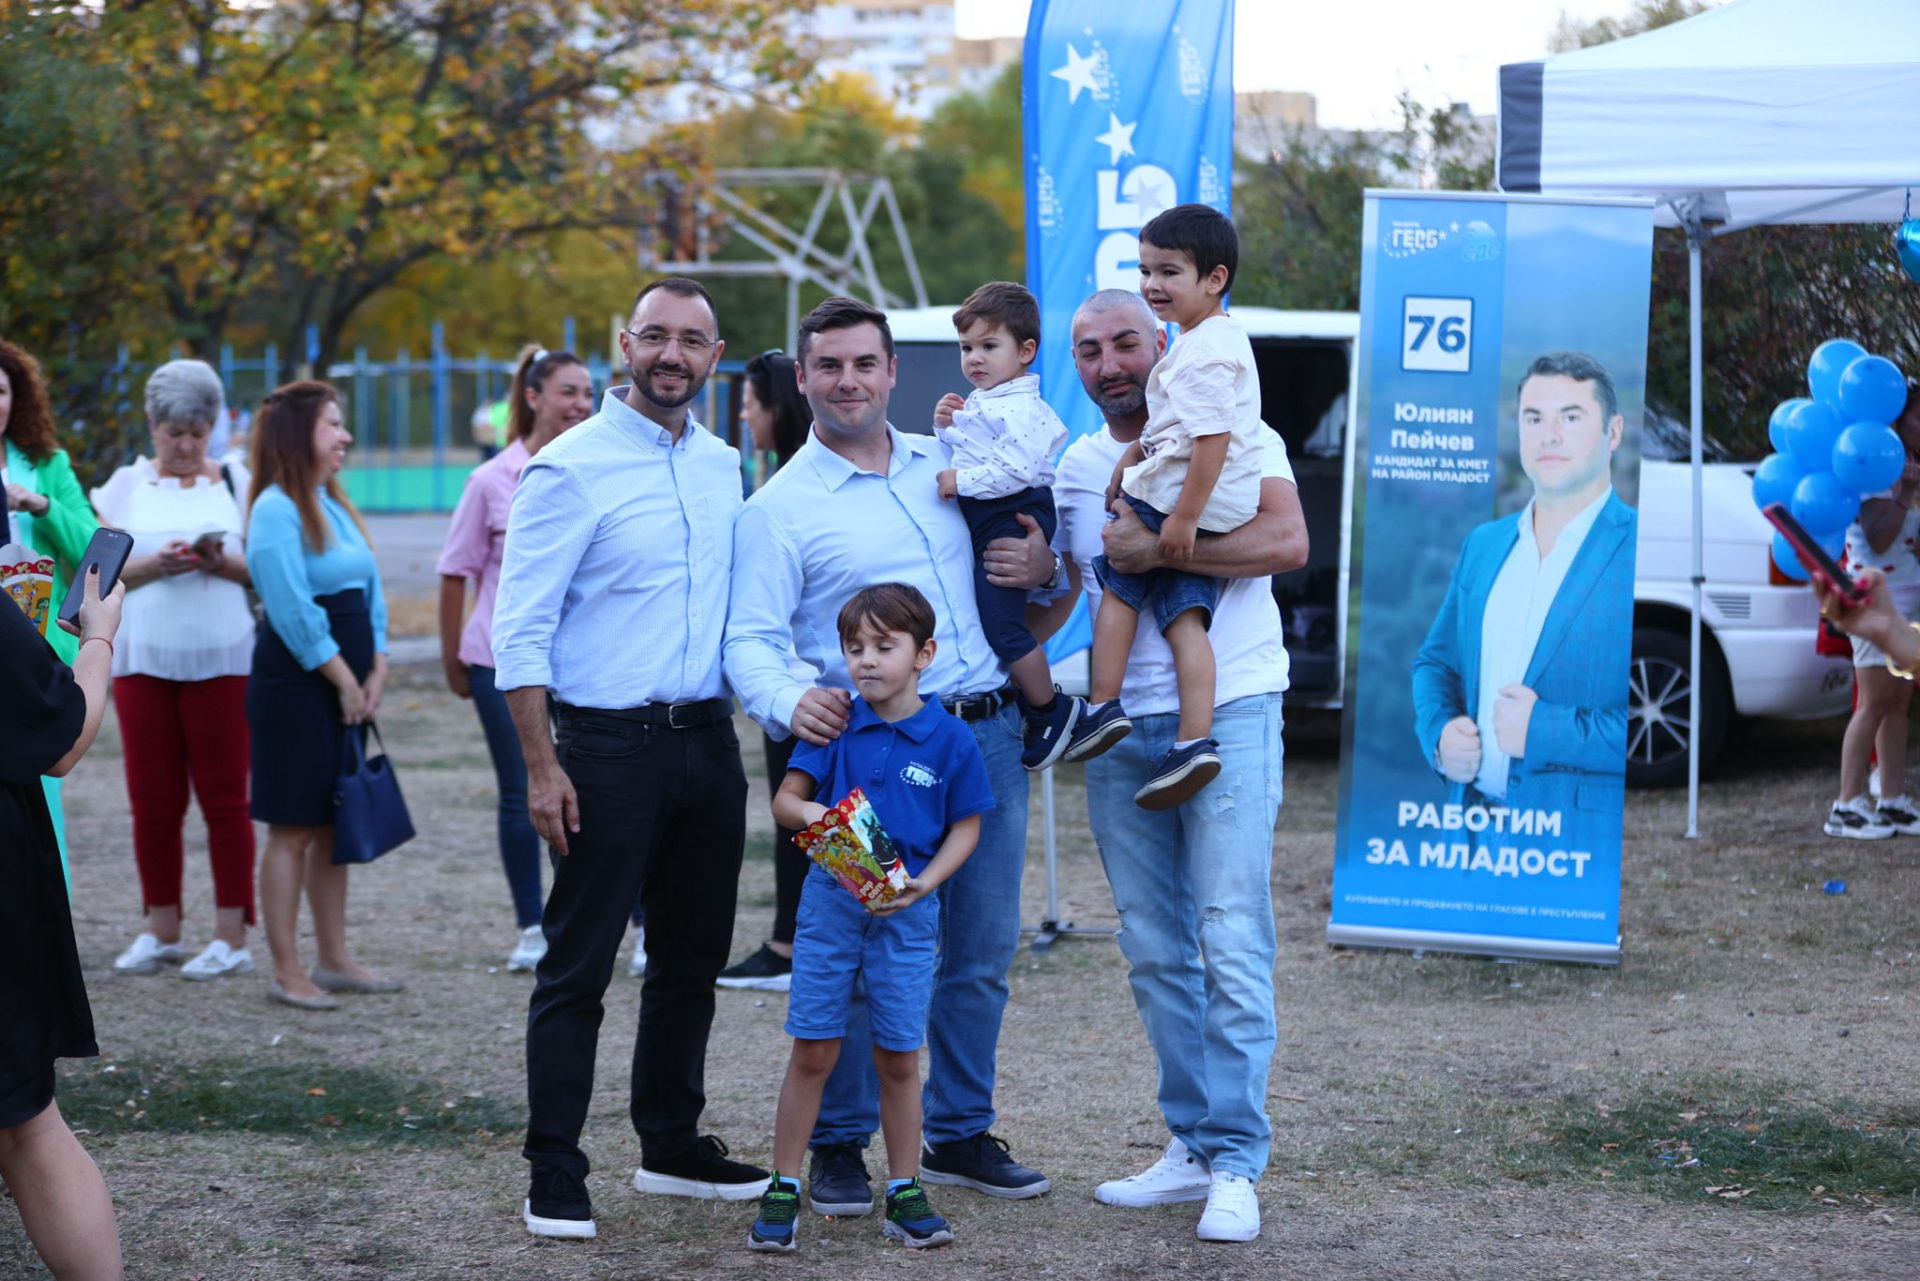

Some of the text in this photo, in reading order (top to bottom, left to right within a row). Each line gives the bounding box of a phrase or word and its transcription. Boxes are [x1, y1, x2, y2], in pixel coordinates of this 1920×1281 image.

[1392, 228, 1439, 250] ГЕРБ
[1408, 315, 1466, 353] 76
[1394, 402, 1473, 424] Юлиян
[1391, 429, 1474, 451] Пейчев
[1374, 455, 1489, 470] КАНДИДАТ ЗА КМЕТ
[1372, 468, 1490, 484] НА РАЙОН МЛАДОСТ
[906, 765, 934, 788] ГЕРБ
[1398, 801, 1562, 837] РАБОТИМ
[1366, 838, 1591, 878] ЗА МЛАДОСТ
[860, 880, 873, 896] pop
[868, 882, 885, 899] corn
